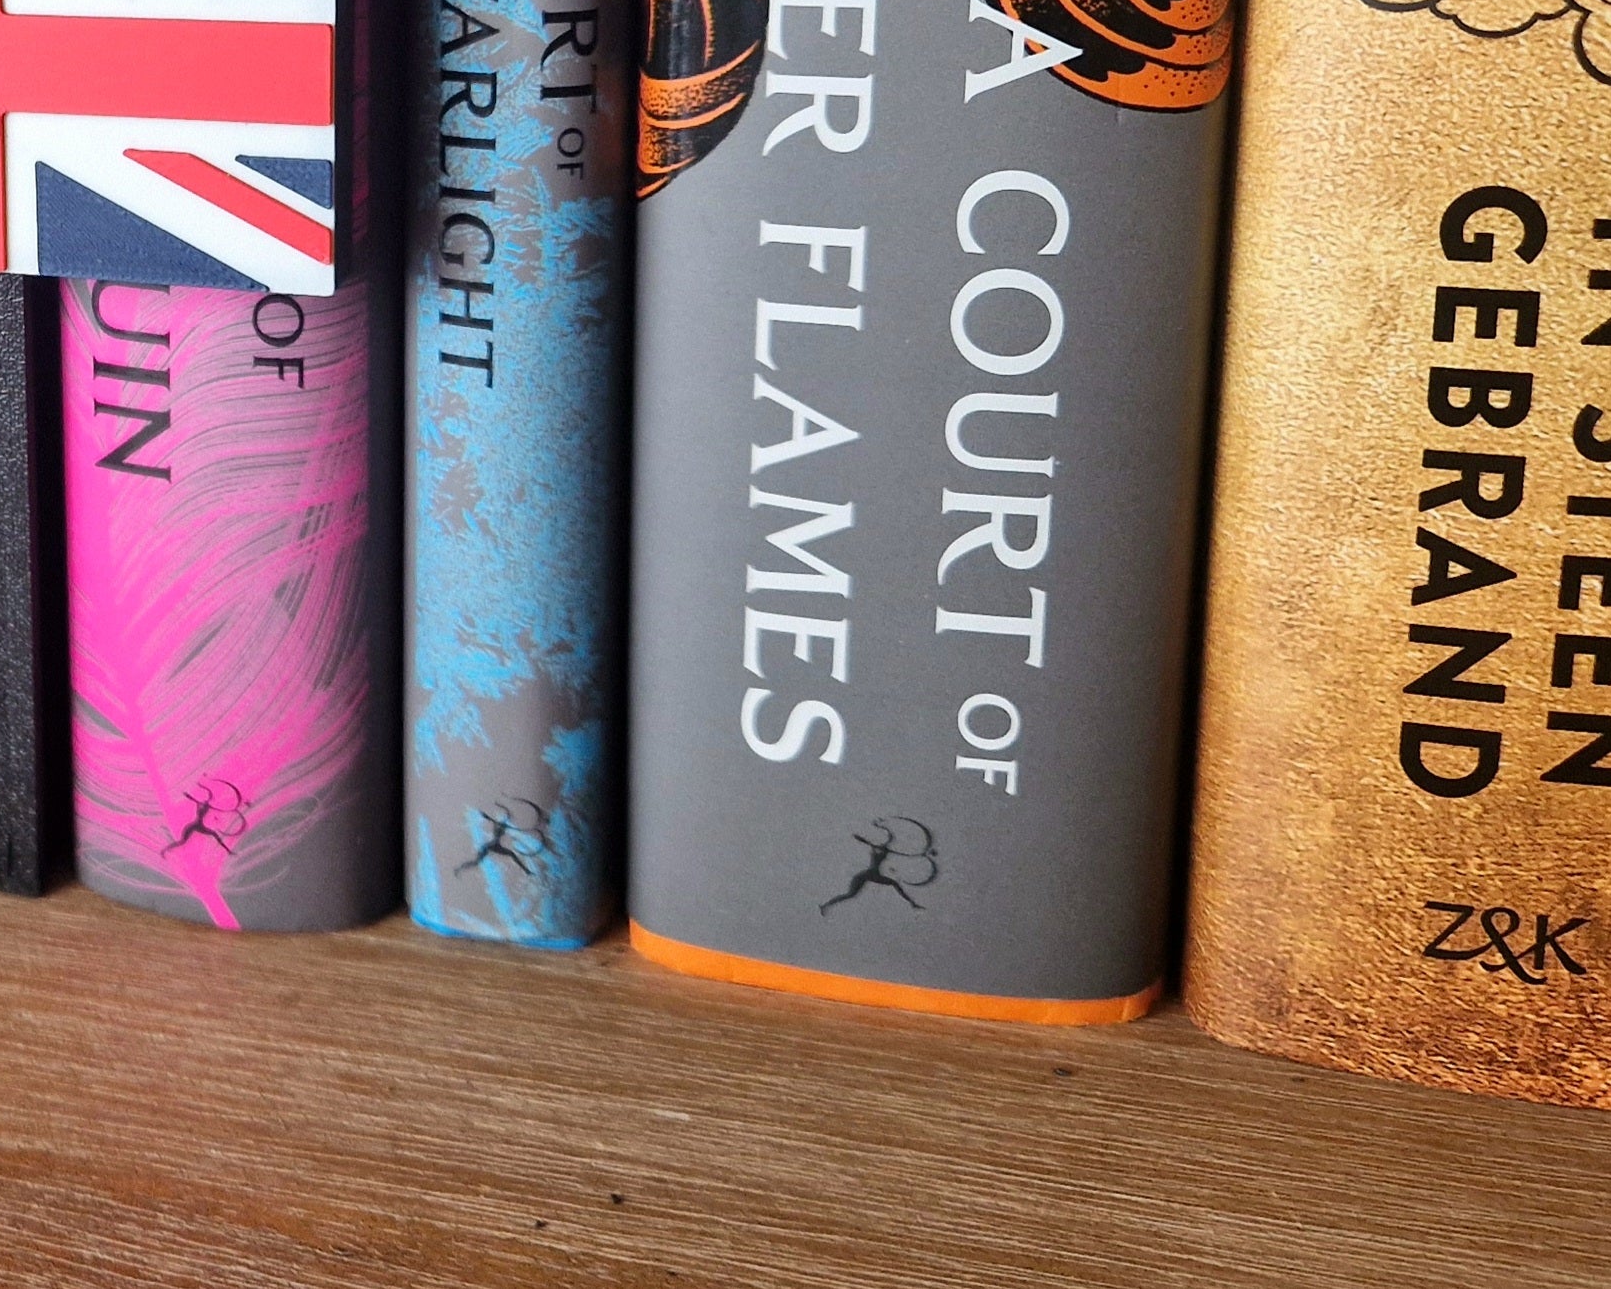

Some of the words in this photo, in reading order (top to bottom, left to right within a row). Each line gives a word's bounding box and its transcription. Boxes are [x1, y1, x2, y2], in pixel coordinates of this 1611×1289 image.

[556, 127, 587, 181] OF
[90, 282, 173, 484] UIN
[252, 291, 306, 389] OF
[741, 219, 870, 766] FLAMES
[934, 169, 1071, 669] COURT
[1398, 185, 1548, 799] GEBRAND
[955, 692, 1021, 797] OF
[1422, 900, 1588, 987] Z&K
